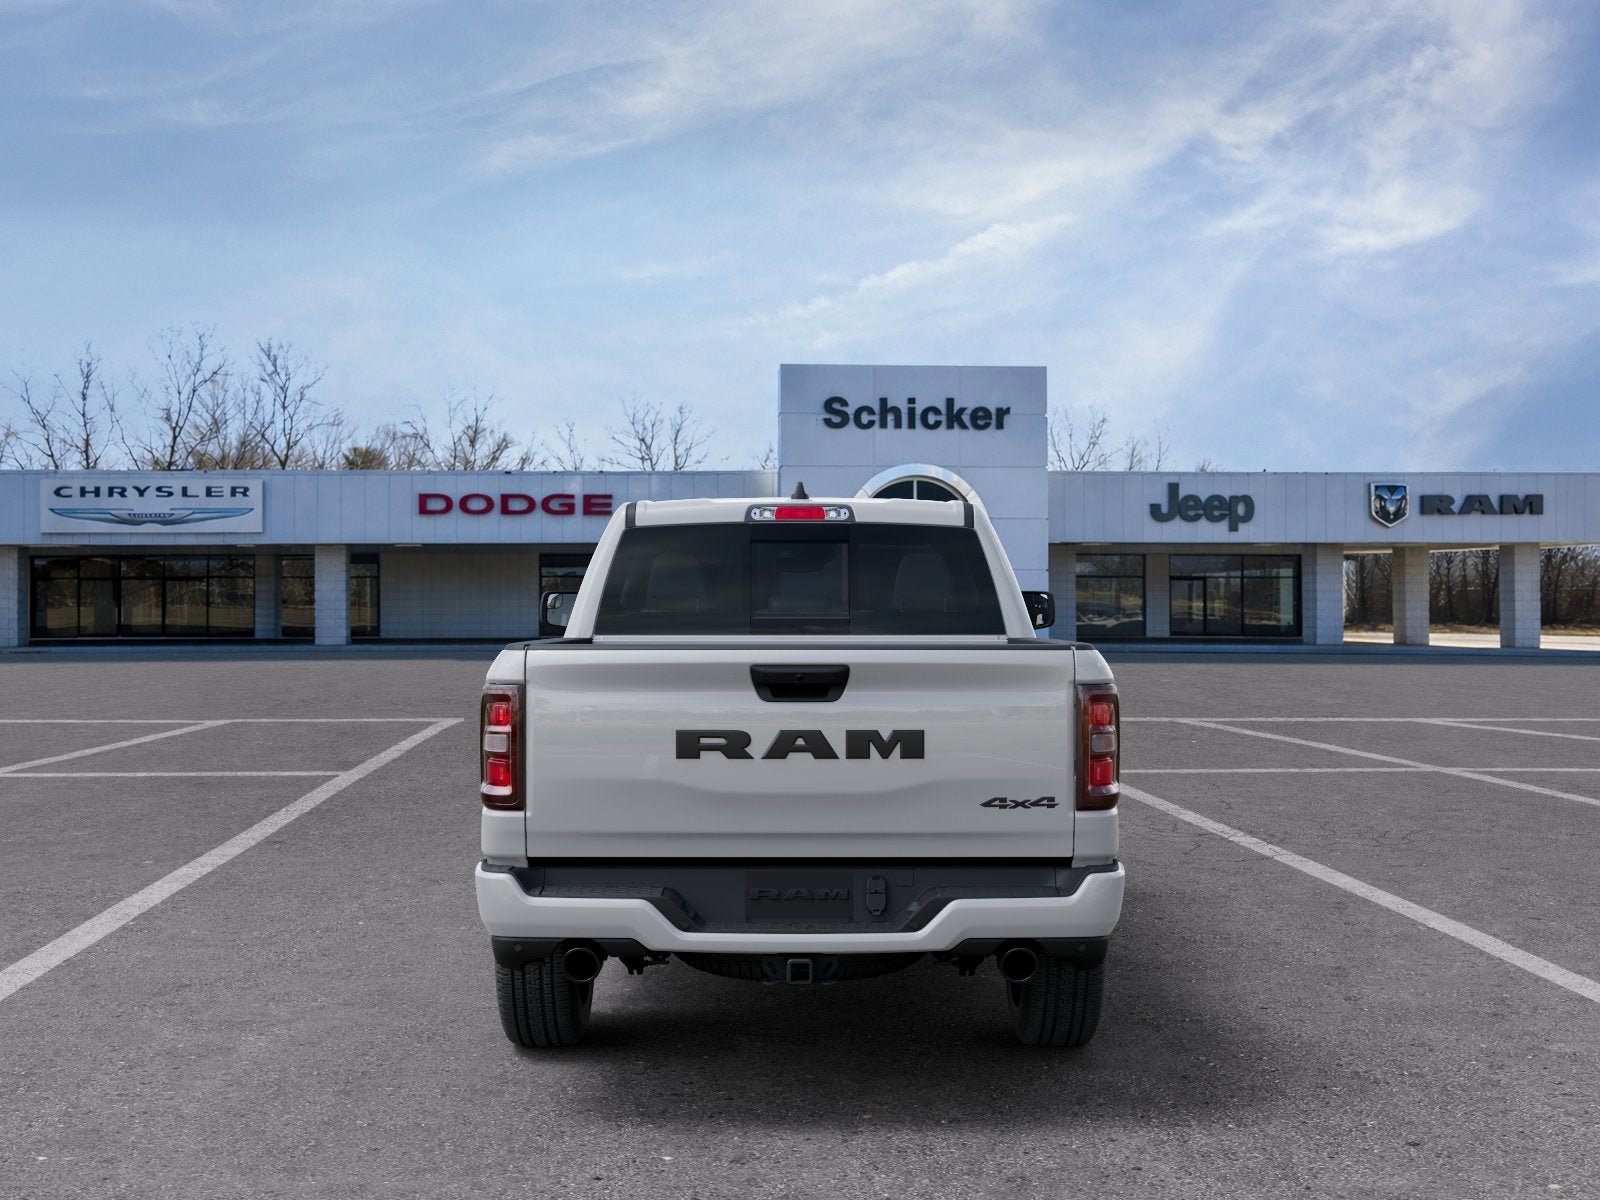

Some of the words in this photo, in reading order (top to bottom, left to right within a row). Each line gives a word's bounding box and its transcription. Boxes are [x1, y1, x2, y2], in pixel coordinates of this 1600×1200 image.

[823, 396, 1011, 430] Schicker
[53, 485, 250, 498] CHRYSLER
[418, 493, 613, 516] DODGE
[1149, 482, 1255, 532] Jeep
[1420, 494, 1544, 515] RAM
[676, 729, 925, 759] RAM
[980, 796, 1060, 809] 4x4
[749, 888, 849, 901] RAM
